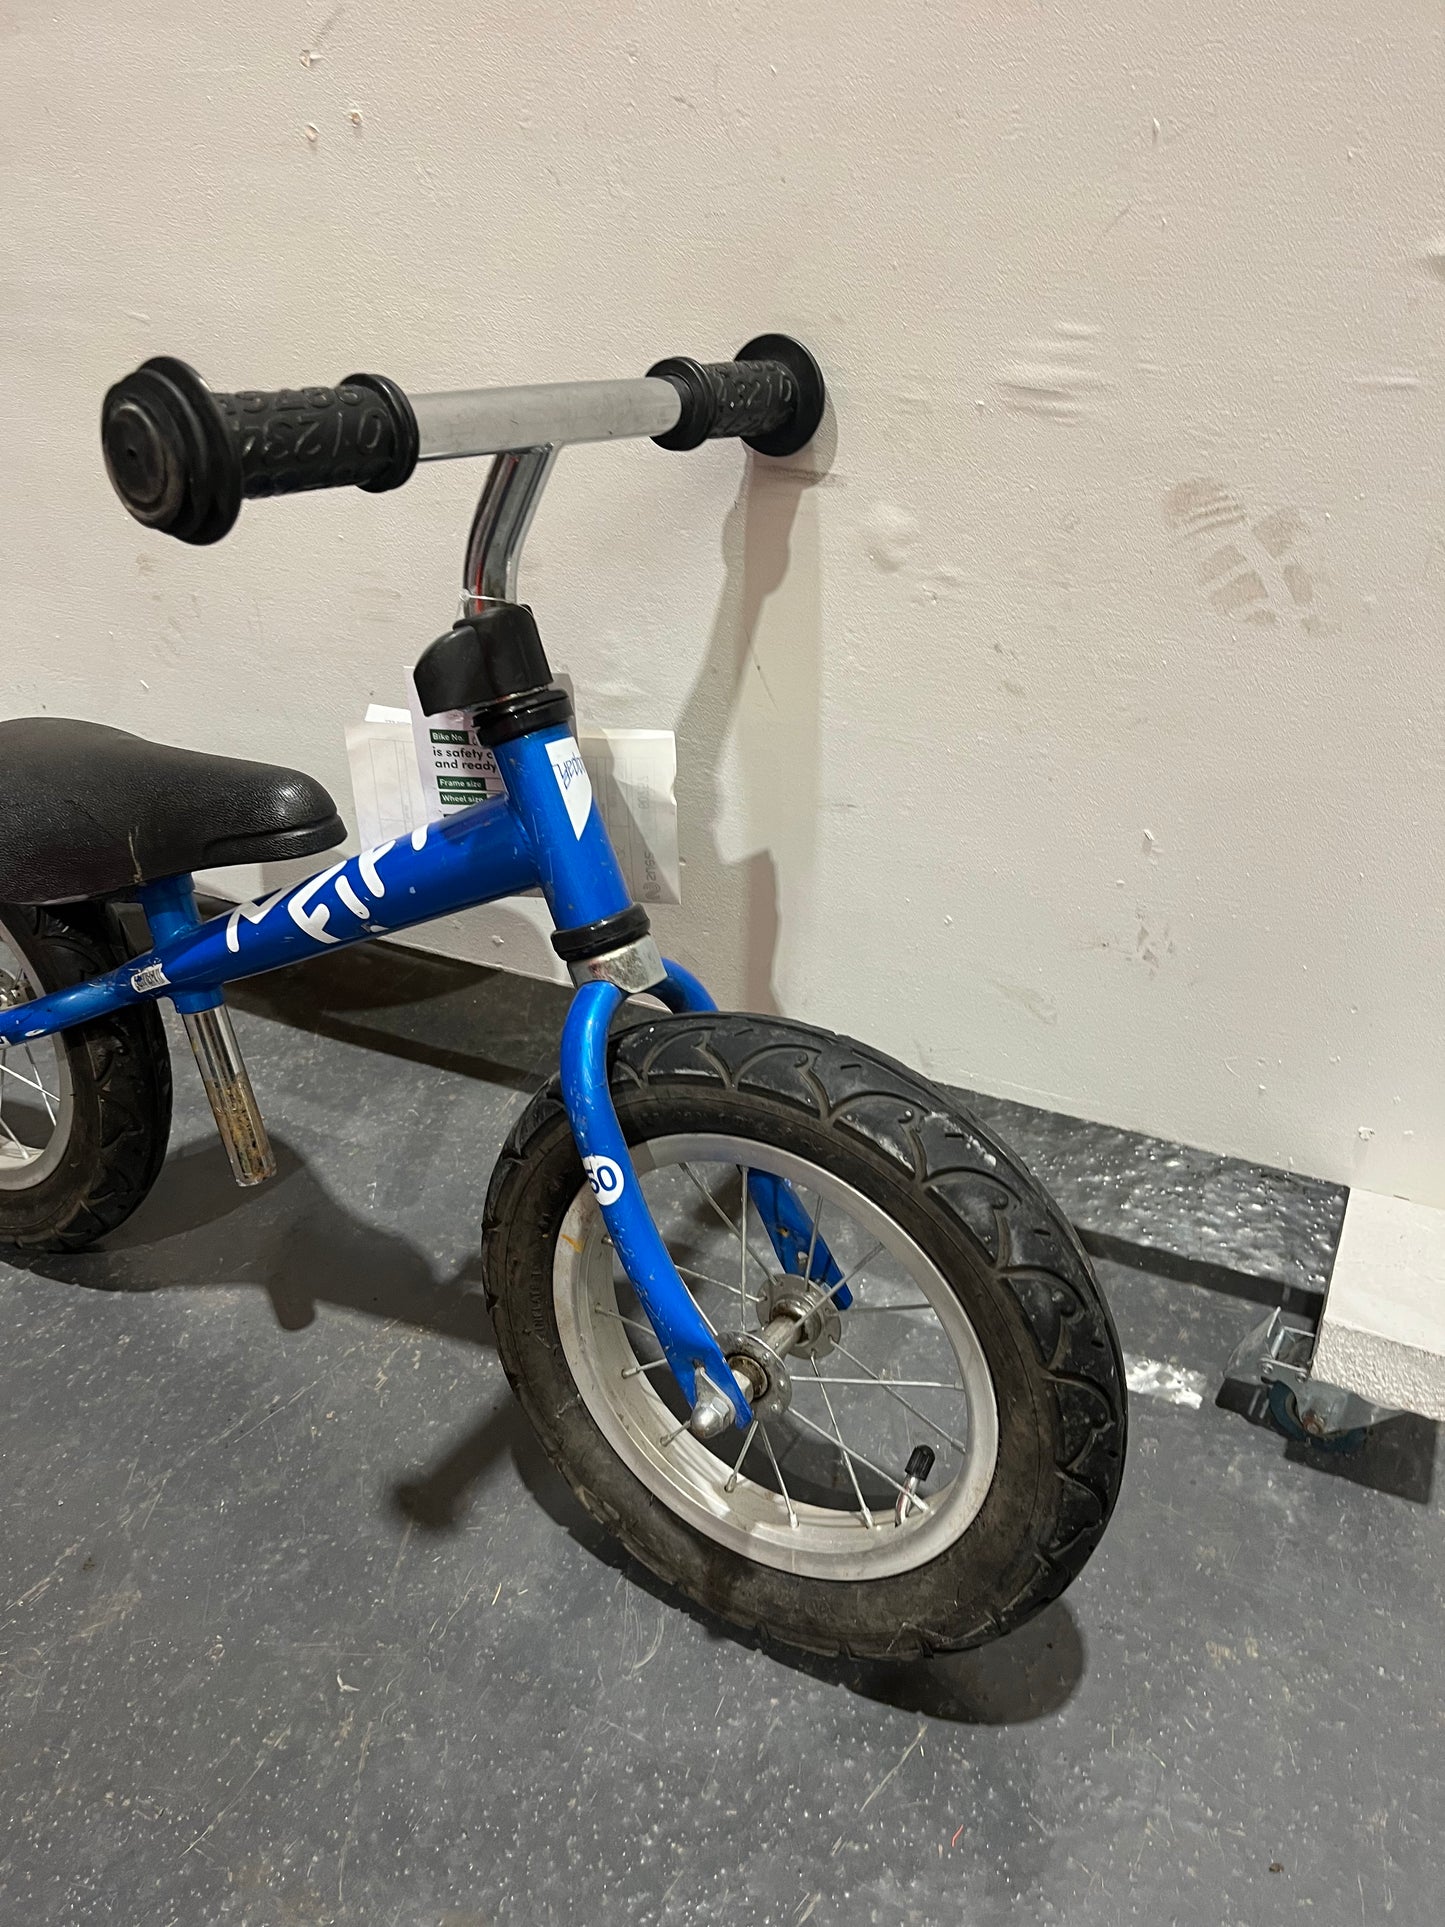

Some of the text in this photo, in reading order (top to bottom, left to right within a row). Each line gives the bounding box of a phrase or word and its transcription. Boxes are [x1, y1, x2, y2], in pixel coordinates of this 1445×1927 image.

[431, 732, 450, 741] Bike
[432, 746, 443, 757] is
[445, 747, 484, 760] safety
[435, 759, 497, 774] and ready
[440, 778, 465, 787] Frame
[441, 794, 484, 804] Wheel size
[585, 1165, 618, 1194] 50
